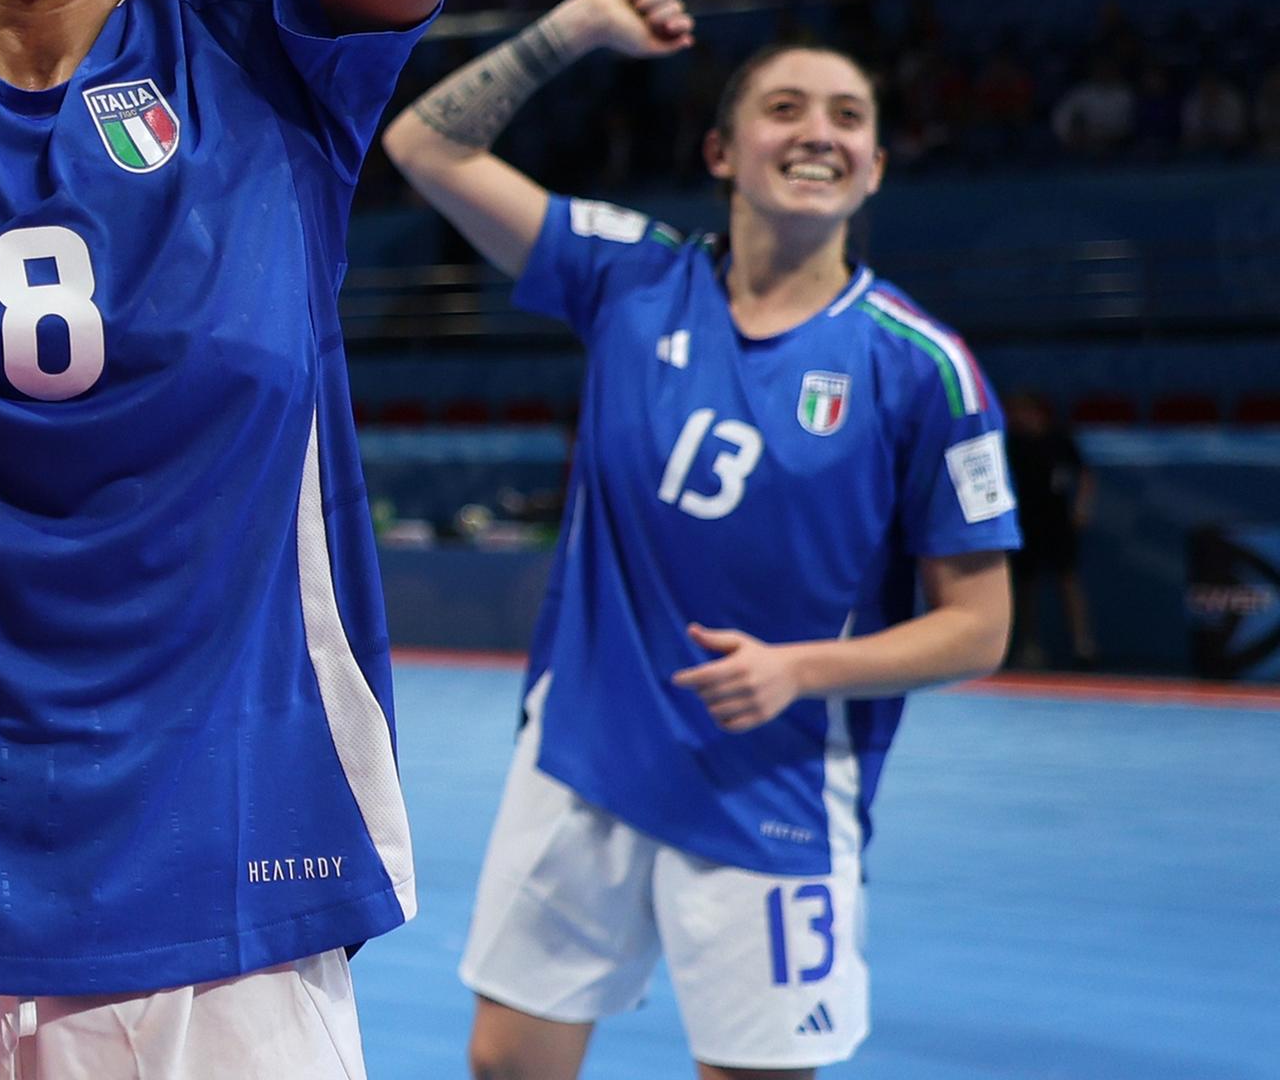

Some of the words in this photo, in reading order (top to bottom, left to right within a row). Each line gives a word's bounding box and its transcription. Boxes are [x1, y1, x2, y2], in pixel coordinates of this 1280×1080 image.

[90, 88, 154, 113] ITALIA
[657, 407, 763, 520] 13
[248, 856, 342, 882] HEAT.RDY
[767, 883, 836, 987] 13
